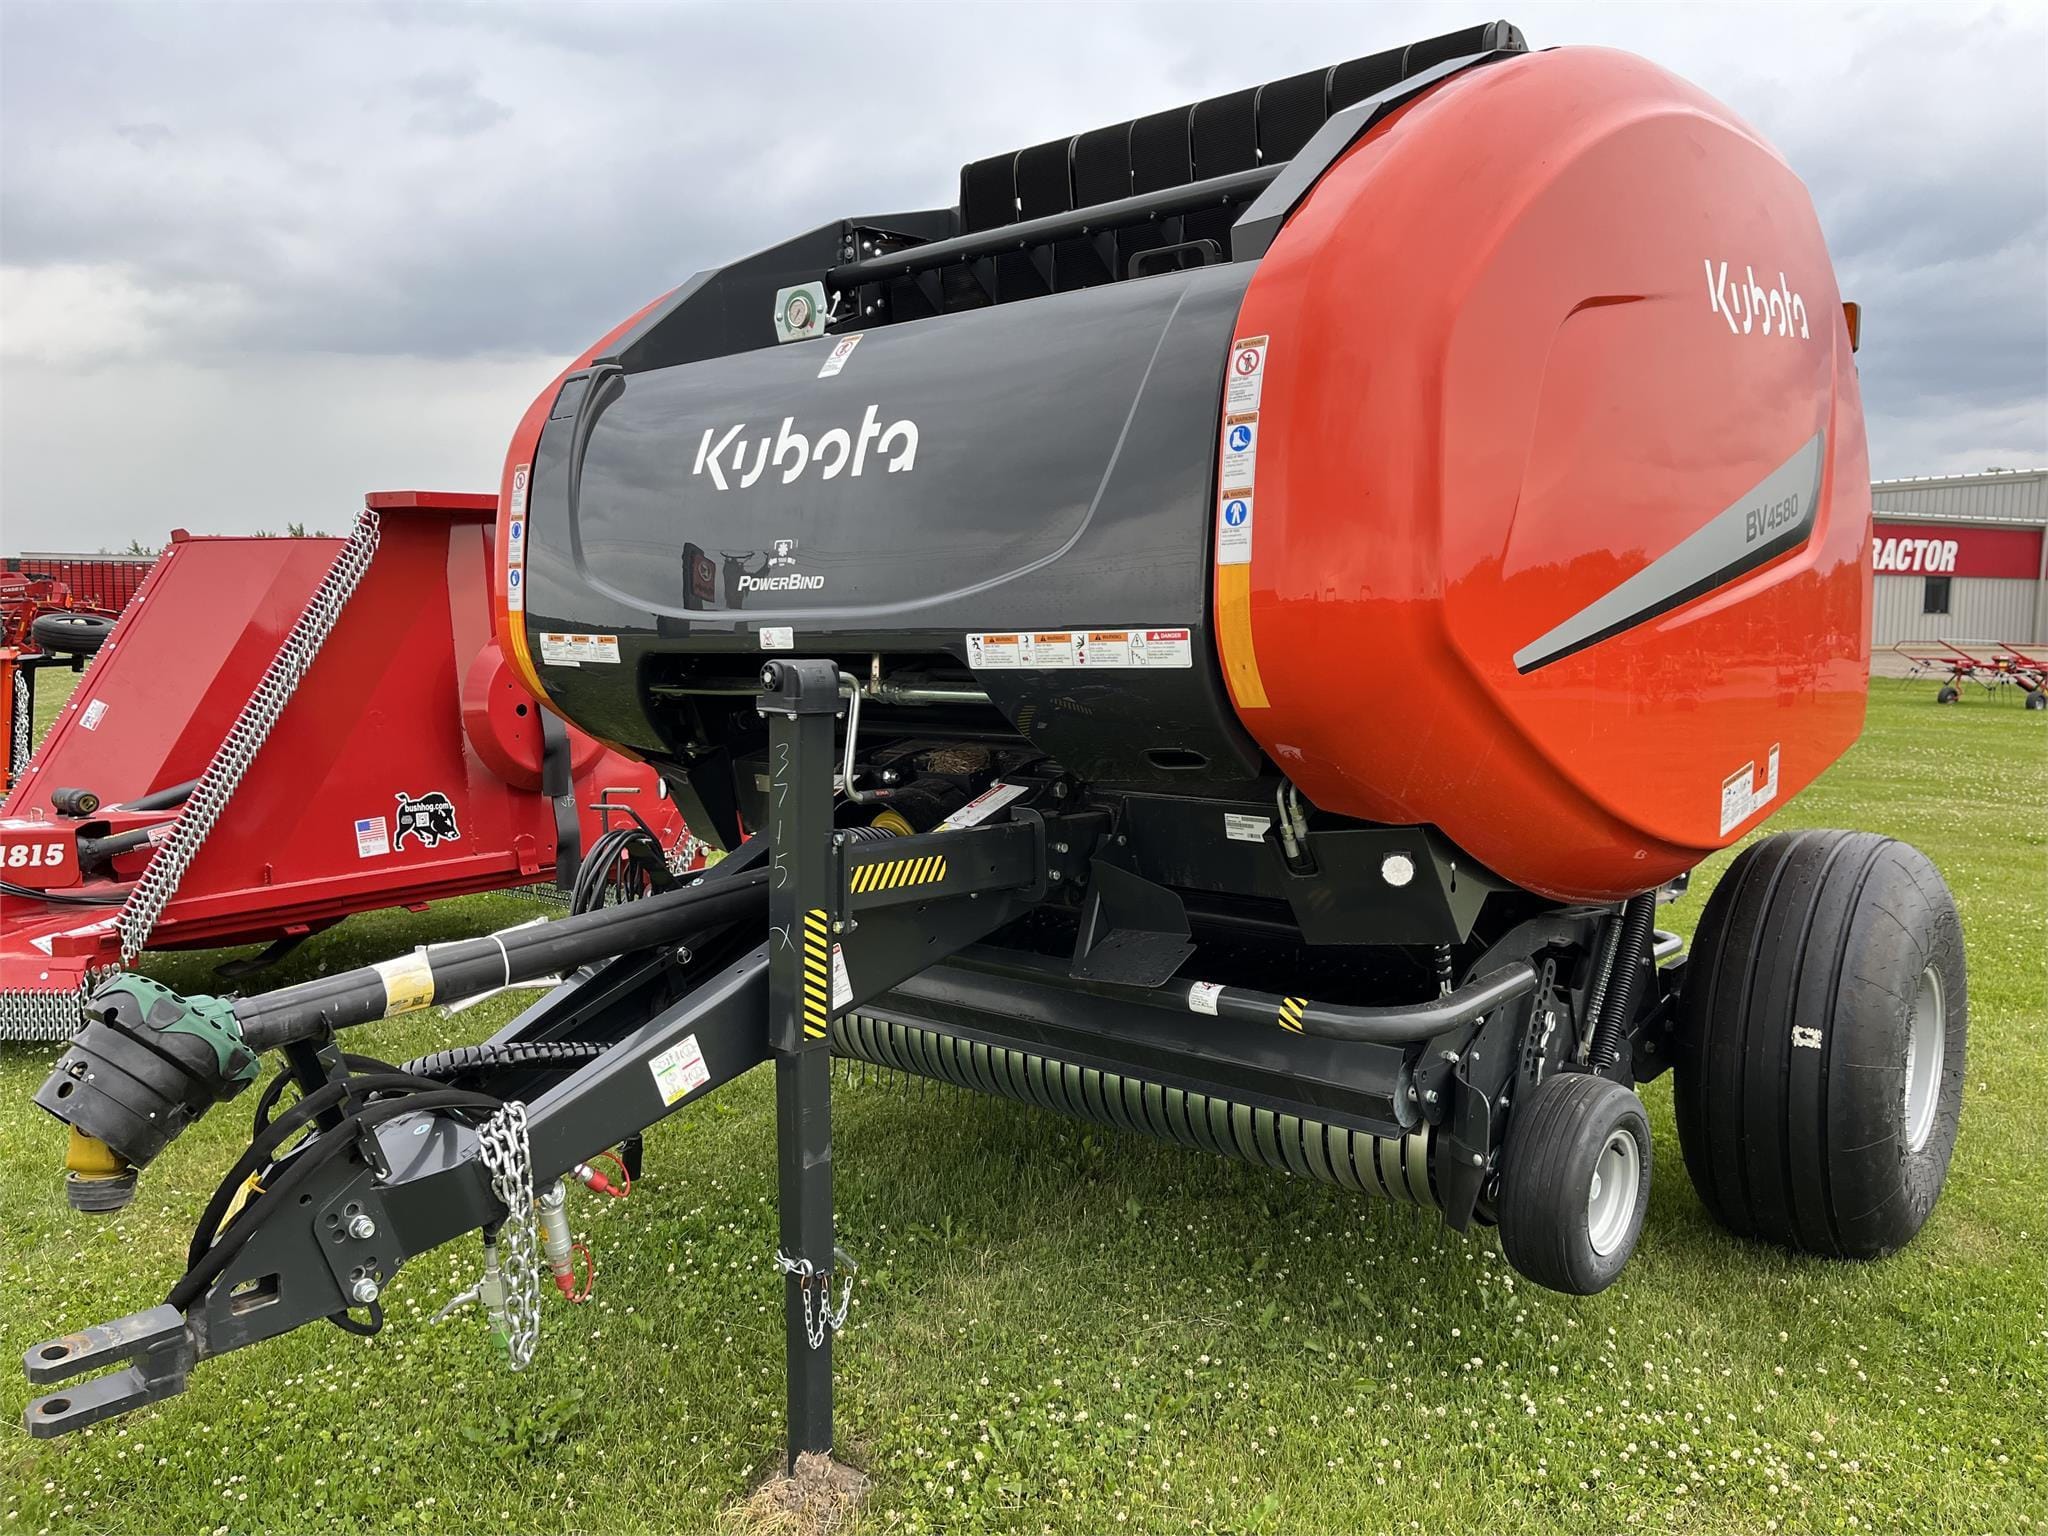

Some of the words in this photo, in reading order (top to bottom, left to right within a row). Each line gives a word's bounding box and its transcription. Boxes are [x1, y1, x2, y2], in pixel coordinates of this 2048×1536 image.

[1704, 259, 1810, 339] Kubota
[692, 404, 919, 491] Kubota
[1746, 493, 1799, 543] BV4580
[404, 802, 450, 813] bushhog.com
